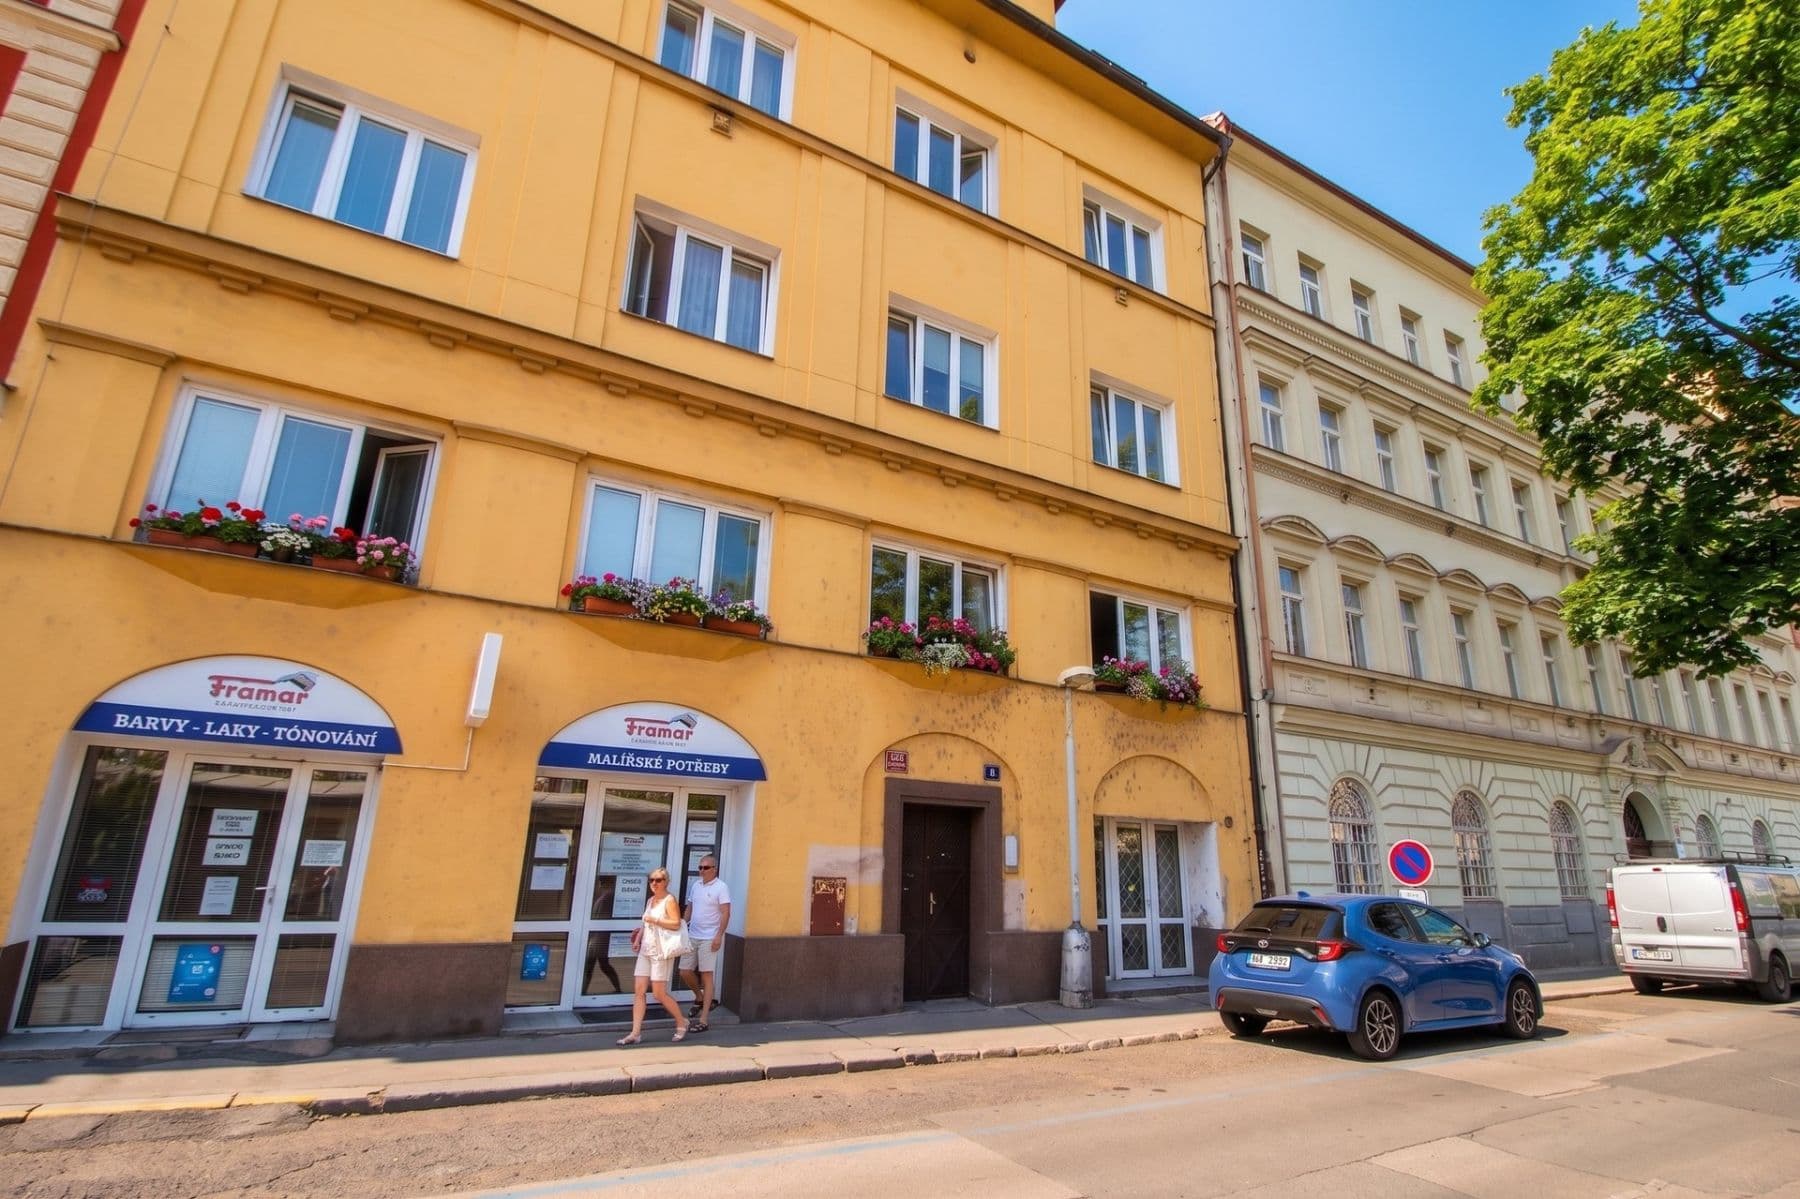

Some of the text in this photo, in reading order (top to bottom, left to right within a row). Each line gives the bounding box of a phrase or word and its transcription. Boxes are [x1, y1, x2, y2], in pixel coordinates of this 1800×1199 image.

[113, 713, 190, 733] BARVY
[203, 721, 261, 739] LAKY
[273, 725, 378, 748] TÓNOVÁNÍ
[587, 752, 730, 775] MALÍŘSKÉ POTŘEBY
